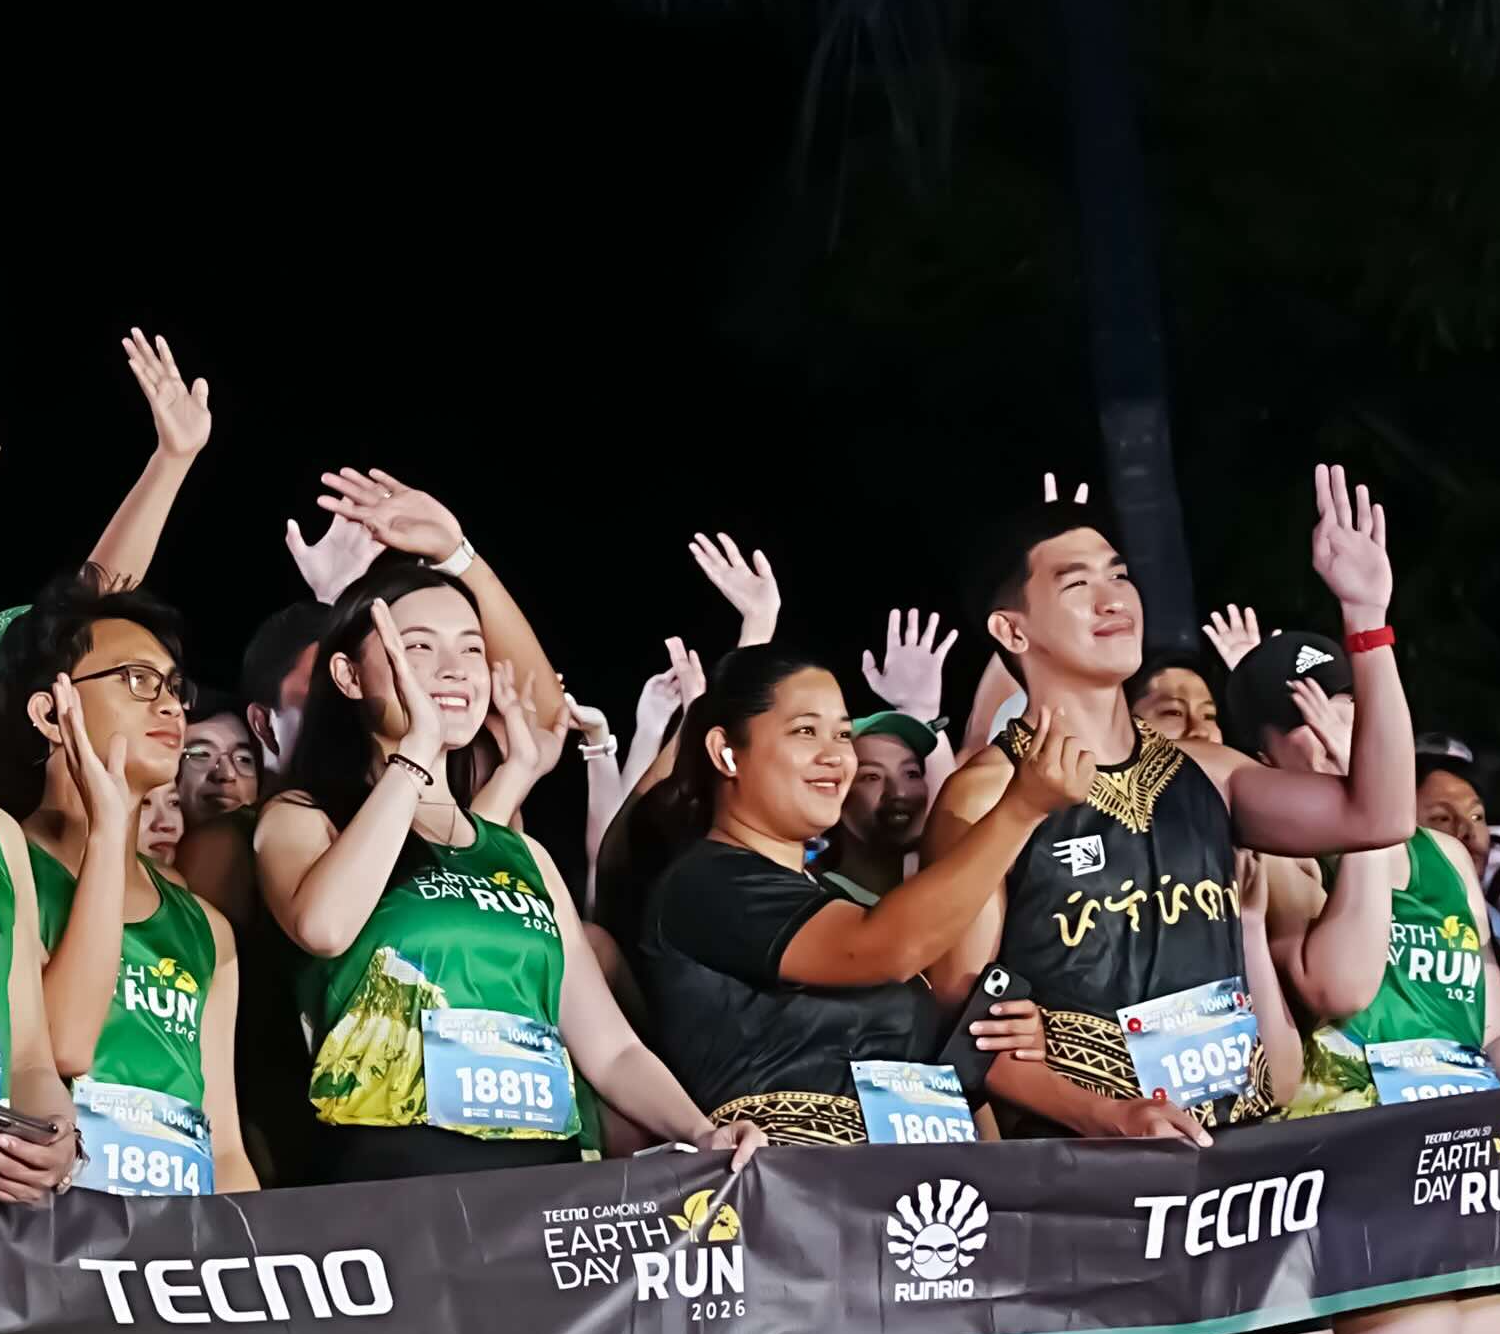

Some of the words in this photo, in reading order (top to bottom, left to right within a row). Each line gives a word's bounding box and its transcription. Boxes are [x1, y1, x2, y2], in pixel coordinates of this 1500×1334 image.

[415, 870, 492, 889] EARTH
[419, 884, 465, 899] DAY
[469, 888, 554, 924] RUN
[1388, 922, 1436, 947] RTH
[1408, 948, 1482, 988] RUN
[456, 1067, 553, 1110] 18813
[103, 1144, 200, 1197] 18814
[1416, 1140, 1490, 1175] EARTH
[1413, 1173, 1457, 1205] DAY
[543, 1207, 589, 1223] TECNO
[592, 1203, 640, 1218] CAMON
[642, 1201, 657, 1214] 50
[1134, 1169, 1324, 1259] TECNO
[543, 1217, 671, 1259] EARTH
[79, 1247, 394, 1325] TECNO
[551, 1254, 621, 1290] DAY
[632, 1245, 744, 1301] RUN
[893, 1280, 975, 1303] RUNRIO
[691, 1299, 745, 1321] 2026
